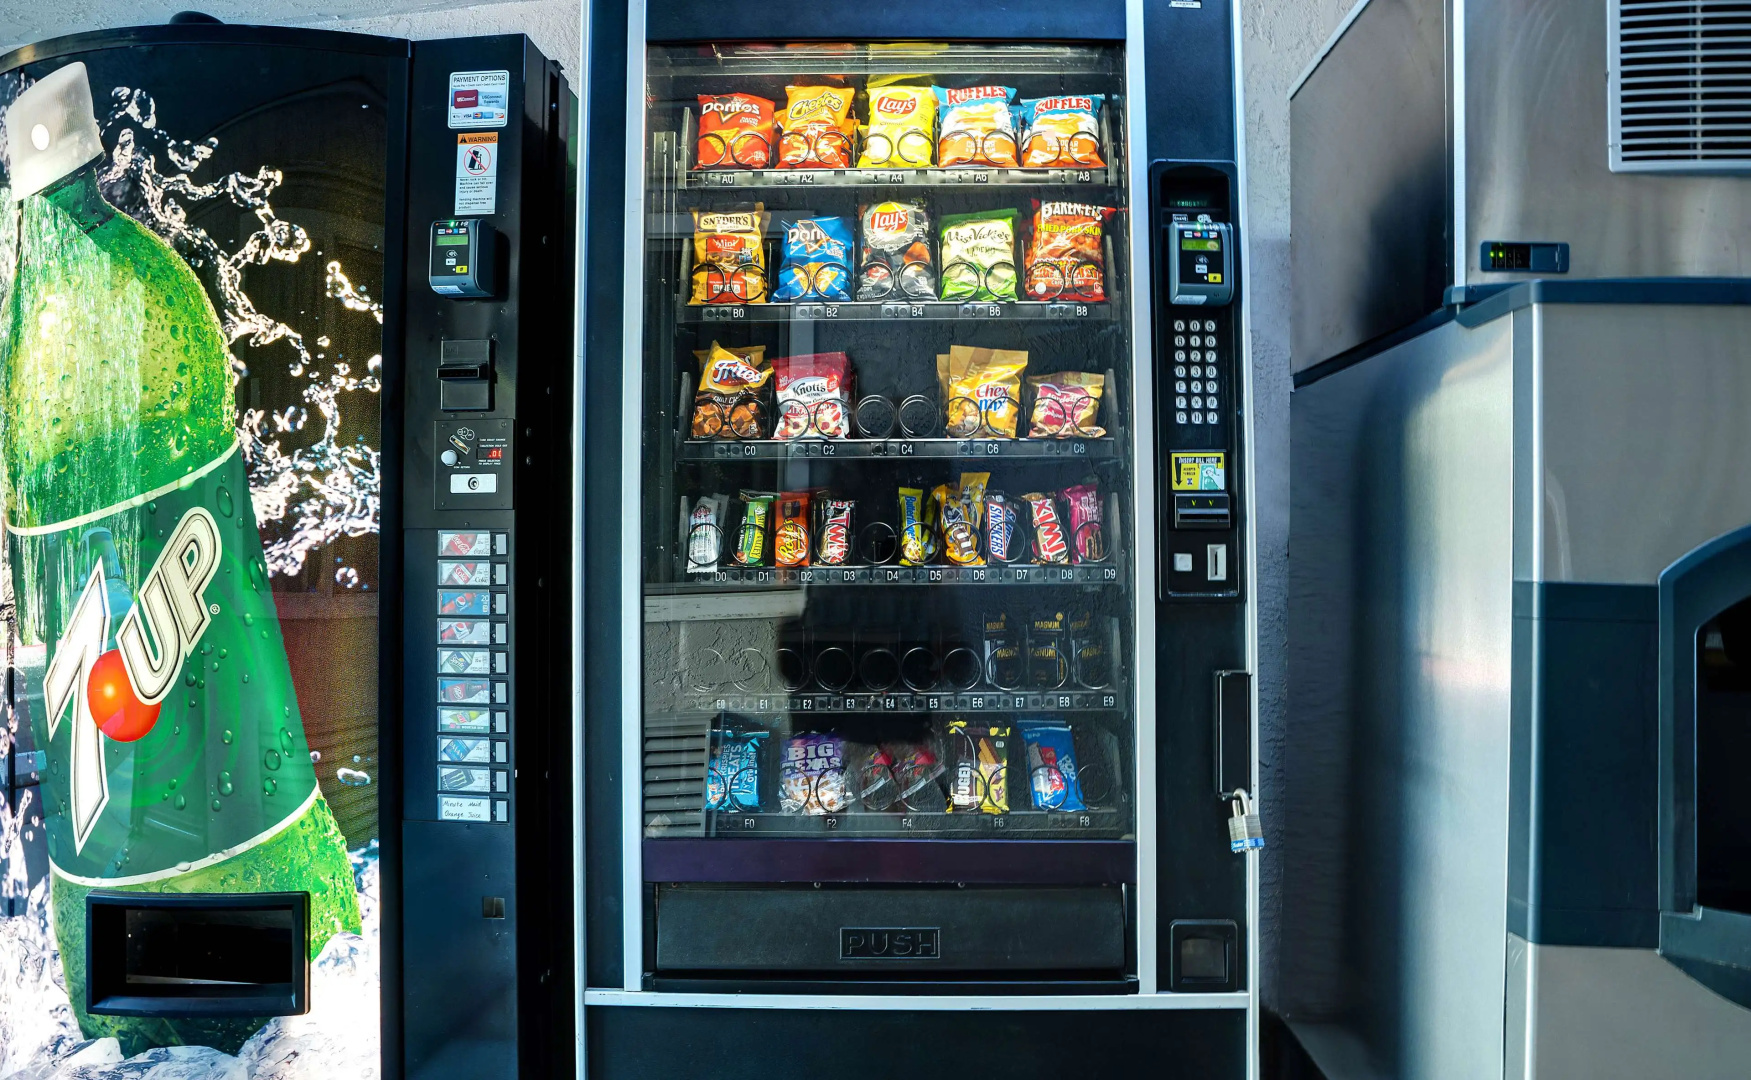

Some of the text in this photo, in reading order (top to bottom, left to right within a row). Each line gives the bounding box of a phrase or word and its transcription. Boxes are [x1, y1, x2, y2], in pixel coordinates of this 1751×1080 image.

[946, 86, 1006, 106] RUFFLES
[702, 102, 760, 115] Doritos
[788, 91, 844, 120] Cheetos
[879, 96, 916, 114] Lay's
[722, 174, 734, 183] A0
[801, 174, 813, 183] A2
[1078, 172, 1090, 181] A8
[703, 216, 750, 226] SNYDER'S
[873, 211, 908, 232] Lay's
[1037, 224, 1059, 233] FRIED
[1060, 225, 1081, 234] PORK
[946, 226, 1010, 246] Miss Vickie's
[716, 238, 736, 248] Mini
[733, 308, 744, 318] B0
[826, 308, 838, 317] B2
[912, 307, 923, 316] B4
[989, 307, 1000, 316] B6
[1076, 306, 1088, 316] B8
[713, 360, 762, 384] Fritos
[793, 382, 826, 396] Knott's
[976, 384, 1010, 398] Chex
[744, 446, 756, 456] C0
[823, 445, 834, 455] C2
[901, 444, 912, 454] C4
[987, 444, 999, 454] C6
[1073, 444, 1085, 453] C8
[990, 504, 1004, 556] SNICKERS
[1032, 499, 1067, 554] TWIX
[715, 572, 727, 581] D0
[758, 572, 769, 581] D1
[800, 572, 812, 581] D2
[843, 571, 855, 580] D3
[887, 570, 898, 580] D4
[930, 570, 941, 580] D5
[973, 570, 985, 580] D6
[1016, 570, 1028, 579] D7
[1061, 570, 1072, 579] D8
[1104, 569, 1116, 579] D9
[1034, 621, 1060, 629] MAGNUM
[716, 699, 725, 709] E0
[760, 699, 768, 709] E1
[803, 699, 812, 709] E2
[846, 699, 855, 709] E3
[886, 699, 894, 709] E4
[929, 698, 938, 708] E5
[972, 698, 983, 708] E6
[1016, 697, 1024, 708] E7
[1060, 697, 1070, 707] E8
[1103, 696, 1114, 706] E9
[788, 743, 834, 760] BIG
[720, 744, 730, 776] KRISPIES
[728, 744, 741, 791] TREATS
[781, 757, 841, 775] TEXAS
[445, 810, 464, 819] Orange
[745, 819, 755, 828] F0
[827, 819, 836, 828] F2
[902, 818, 912, 828] F4
[994, 818, 1004, 827] F6
[1080, 816, 1090, 826] F8
[846, 932, 936, 955] PUSH
